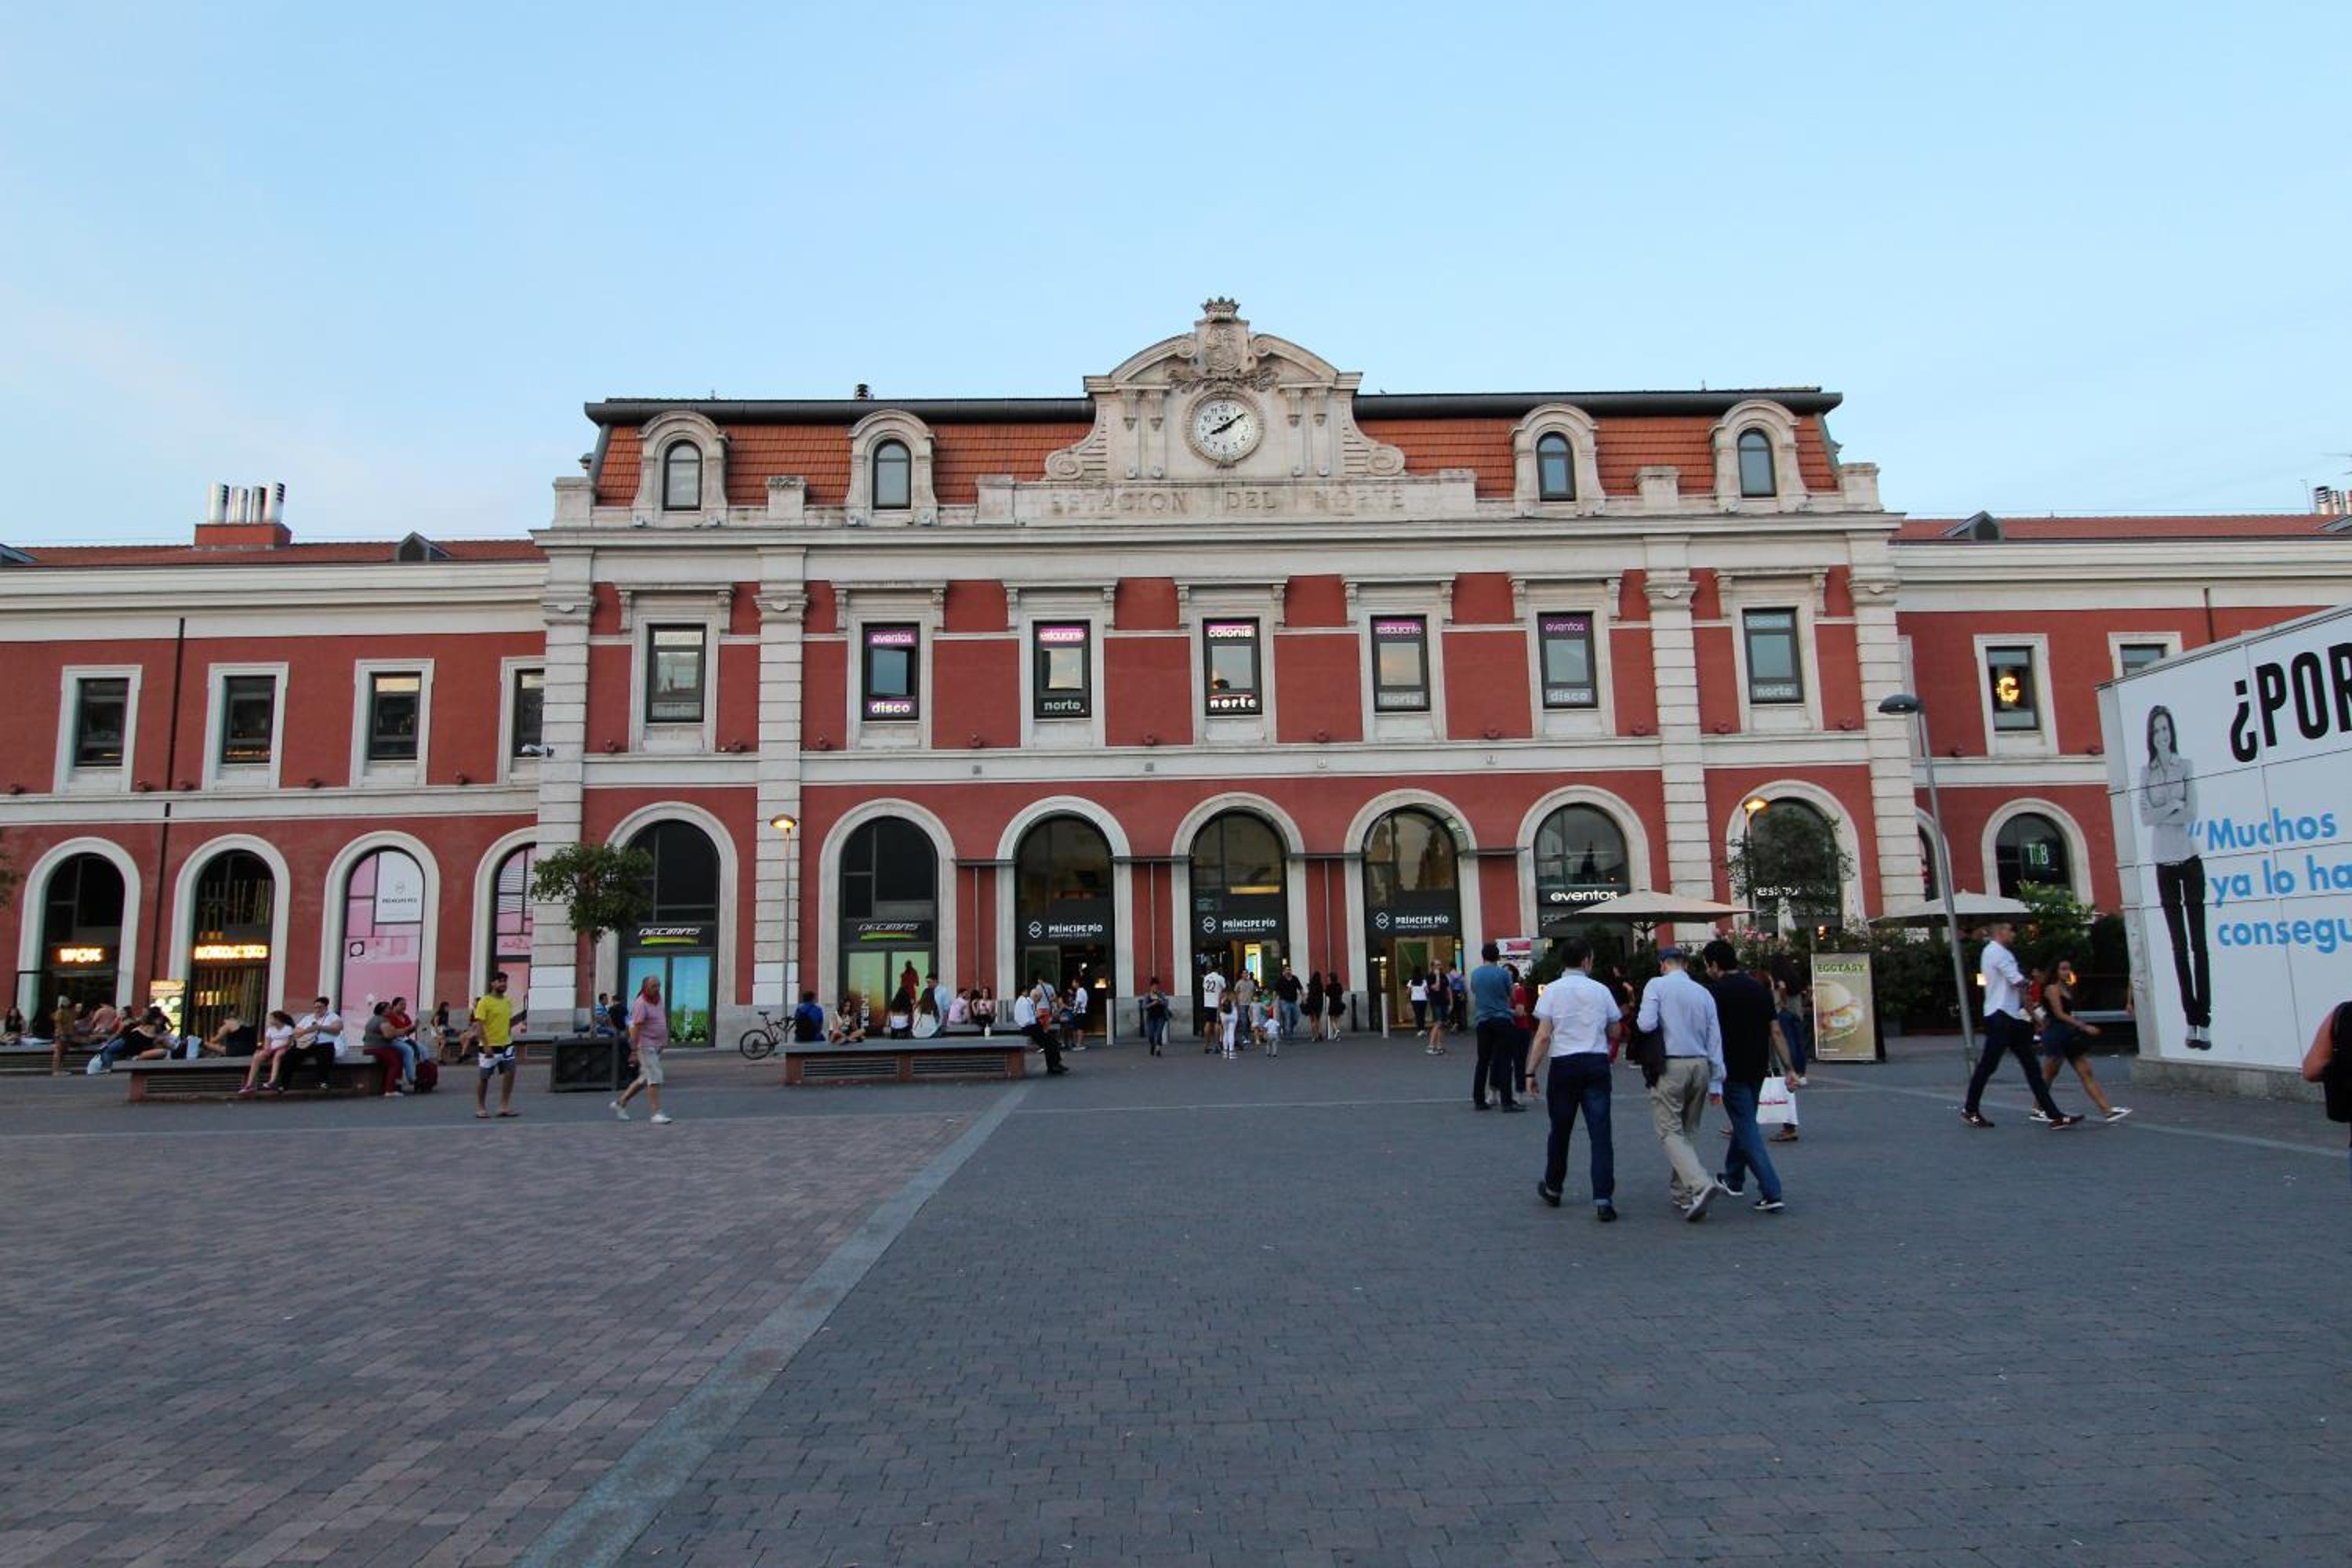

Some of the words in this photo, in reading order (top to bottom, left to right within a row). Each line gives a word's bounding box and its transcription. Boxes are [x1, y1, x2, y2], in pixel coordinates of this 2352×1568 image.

[1226, 491, 1277, 508] DEL
[1550, 691, 1588, 702] disco
[871, 702, 910, 713] disco
[1044, 699, 1081, 710] norte
[1210, 697, 1256, 708] norte
[2209, 874, 2252, 908] ya
[2263, 859, 2296, 895] lo
[1550, 890, 1618, 902] eventos
[60, 948, 102, 962] WOK
